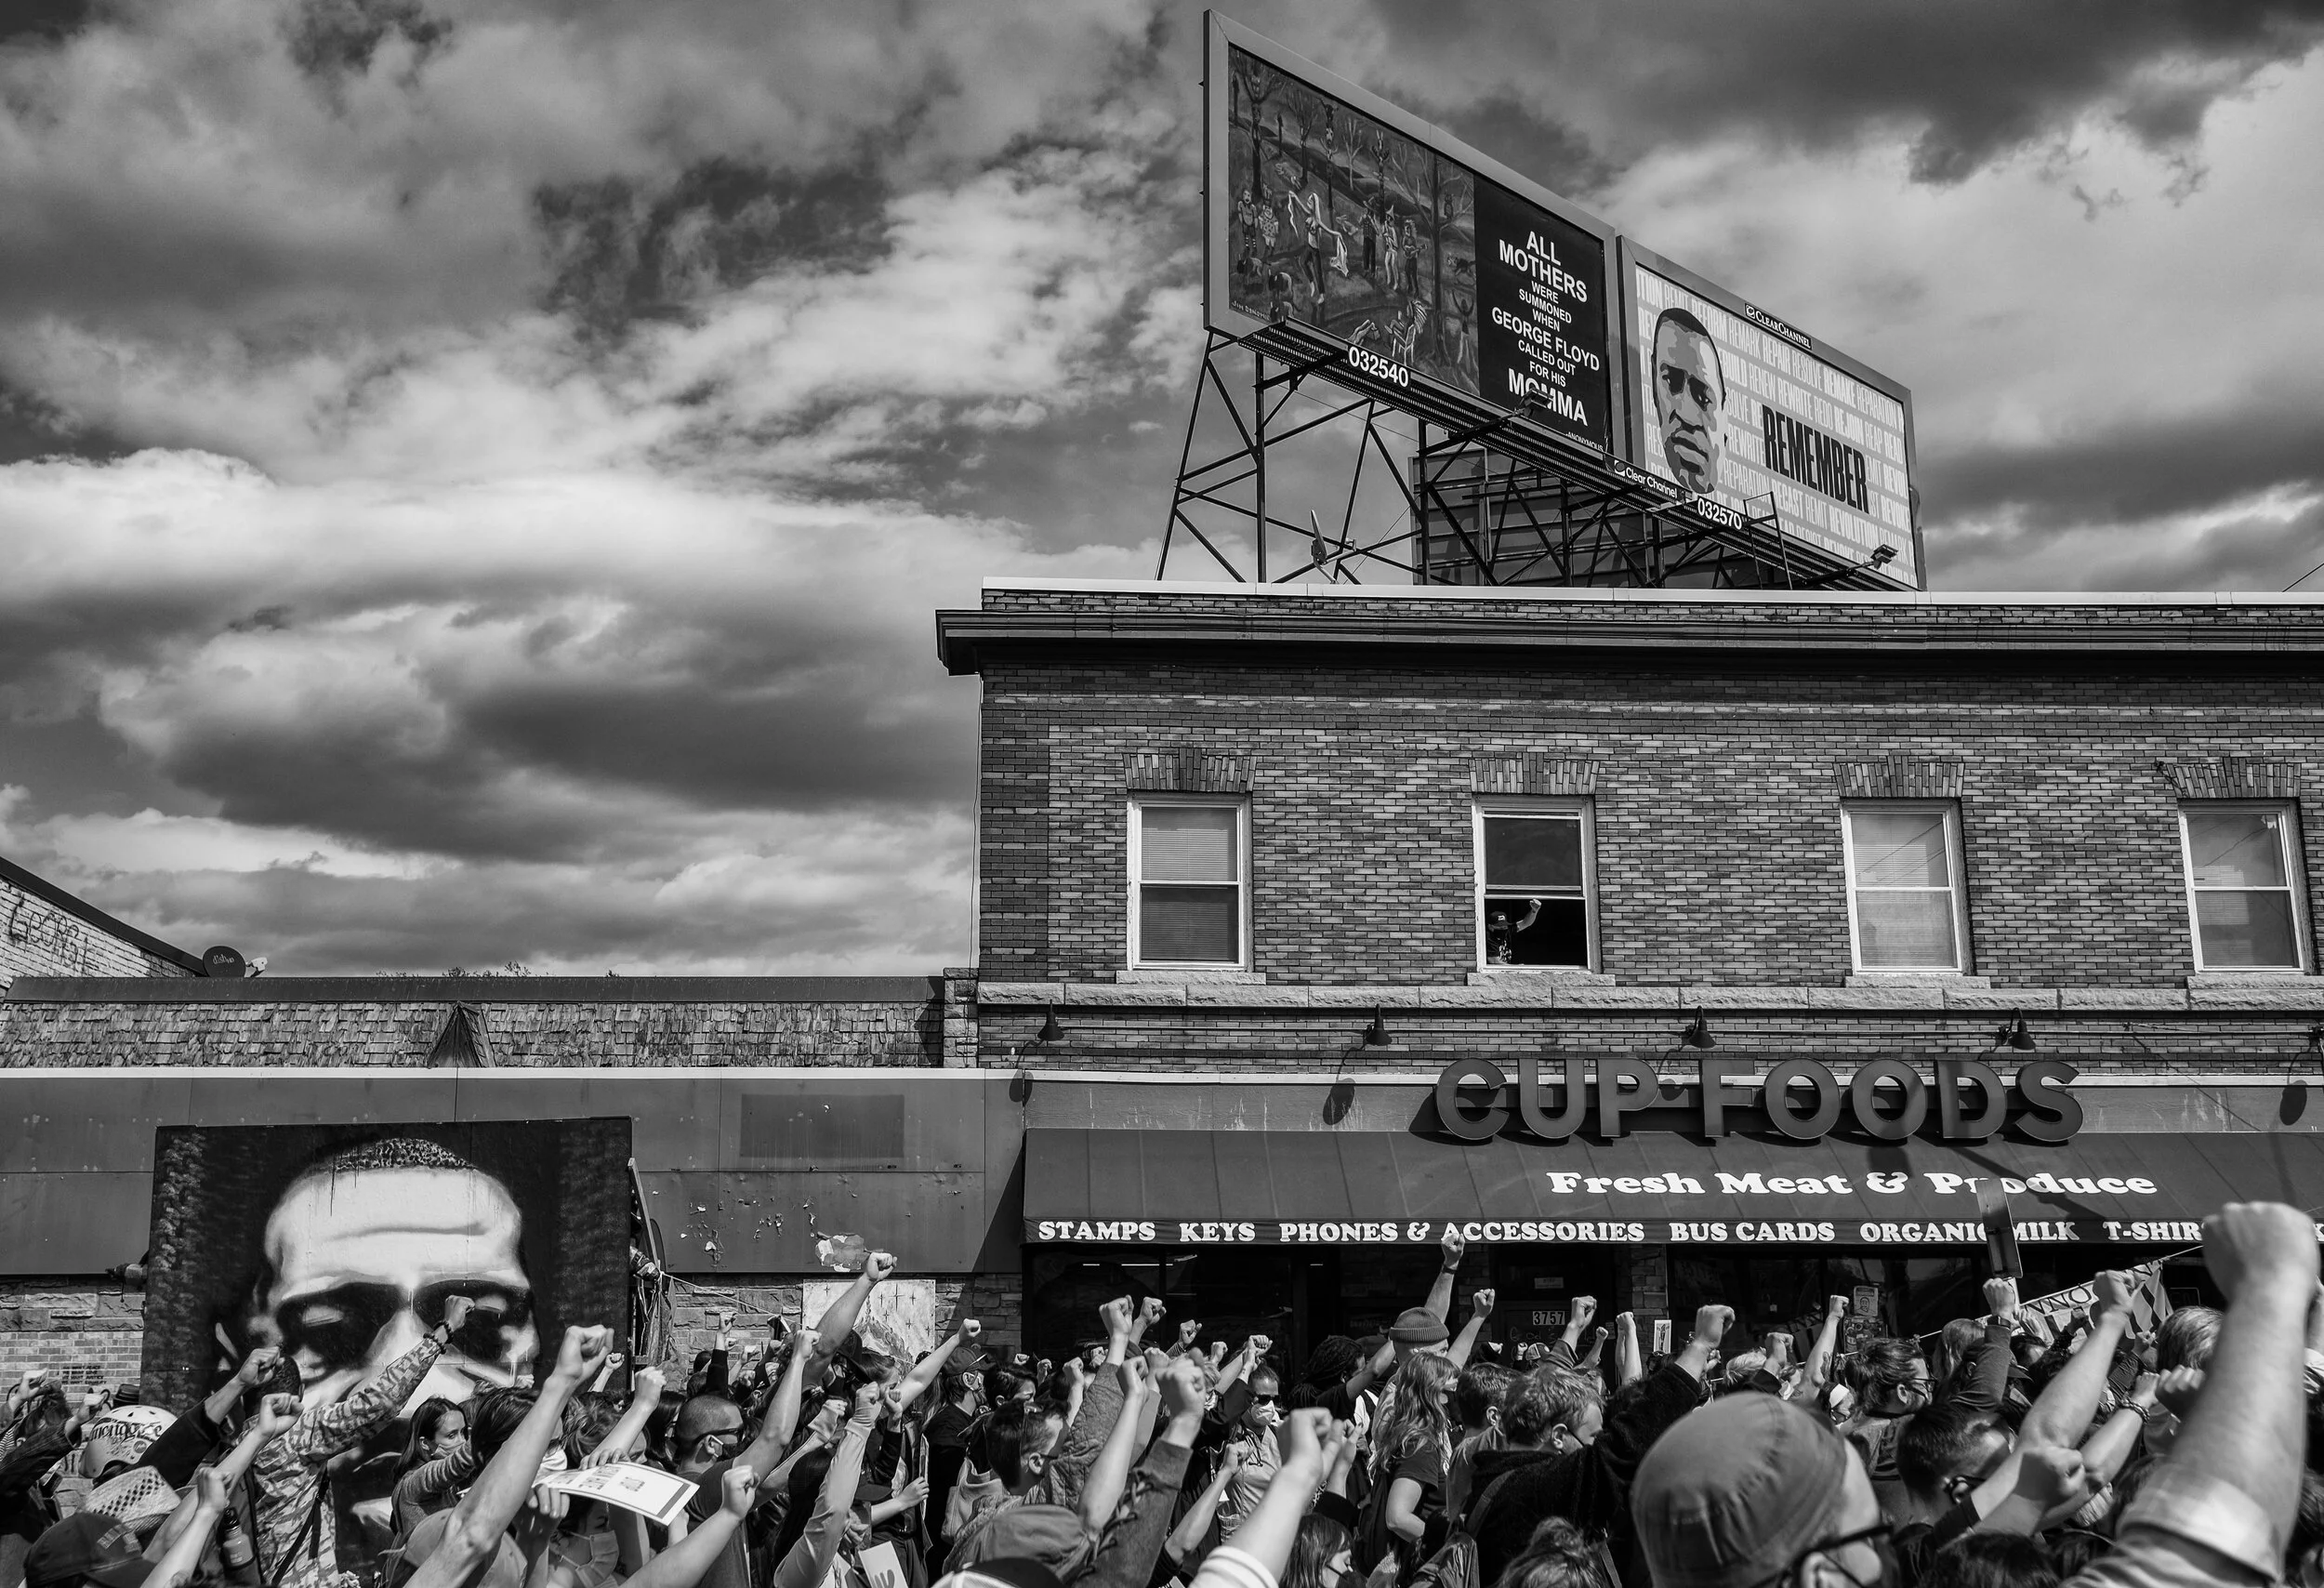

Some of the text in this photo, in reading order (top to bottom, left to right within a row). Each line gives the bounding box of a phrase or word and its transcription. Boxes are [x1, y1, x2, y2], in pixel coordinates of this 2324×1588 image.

[1526, 231, 1562, 266] ALL
[1499, 239, 1588, 303] MOTHERS
[1519, 288, 1572, 324] SUMMONED
[1531, 281, 1559, 304] WERE
[1532, 309, 1560, 332] WHEN
[1492, 307, 1552, 349] GEORGE
[1555, 337, 1600, 371] FLOYD
[1348, 346, 1409, 388] 032540
[1518, 339, 1576, 376] CALLED OUT
[1529, 361, 1566, 387] FOR HIS
[1727, 316, 1762, 361] REMARK
[1761, 333, 1791, 376] REPAIR
[1790, 349, 1822, 391] RESOLVE
[1822, 365, 1856, 408] REMAKE
[1855, 382, 1896, 429] REPARATION
[1748, 362, 1776, 403] RENEW
[1776, 376, 1813, 420] REWRITE
[1813, 393, 1833, 430] REDO
[1833, 404, 1864, 445] REJOIN
[1864, 419, 1883, 455] REAP
[1882, 429, 1903, 465] READ
[1762, 404, 1869, 515] REMEMBER
[1864, 453, 1882, 487] EMIT
[1626, 467, 1646, 484] Clear
[1646, 476, 1678, 498] Channel
[1697, 497, 1742, 530] 032570
[1804, 493, 1829, 531] REMIT
[1828, 504, 1880, 553] REVOLUTION
[1436, 1057, 2083, 1142] CUP FOODS
[1545, 1171, 1706, 1194] Fresh
[1714, 1171, 1854, 1195] Meat
[1866, 1171, 1908, 1194] &
[1038, 1221, 1156, 1241] STAMPS
[1179, 1222, 1256, 1242] KEYS
[1279, 1222, 1398, 1242] PHONES
[1406, 1222, 1431, 1241] &
[1440, 1222, 1645, 1242] ACCESSORIES
[1670, 1222, 1728, 1243] BUS
[1736, 1222, 1835, 1242] CARDS
[2012, 1221, 2080, 1241] MILK
[2103, 1221, 2204, 1241] T-SHIR
[1533, 1311, 1565, 1325] 3757
